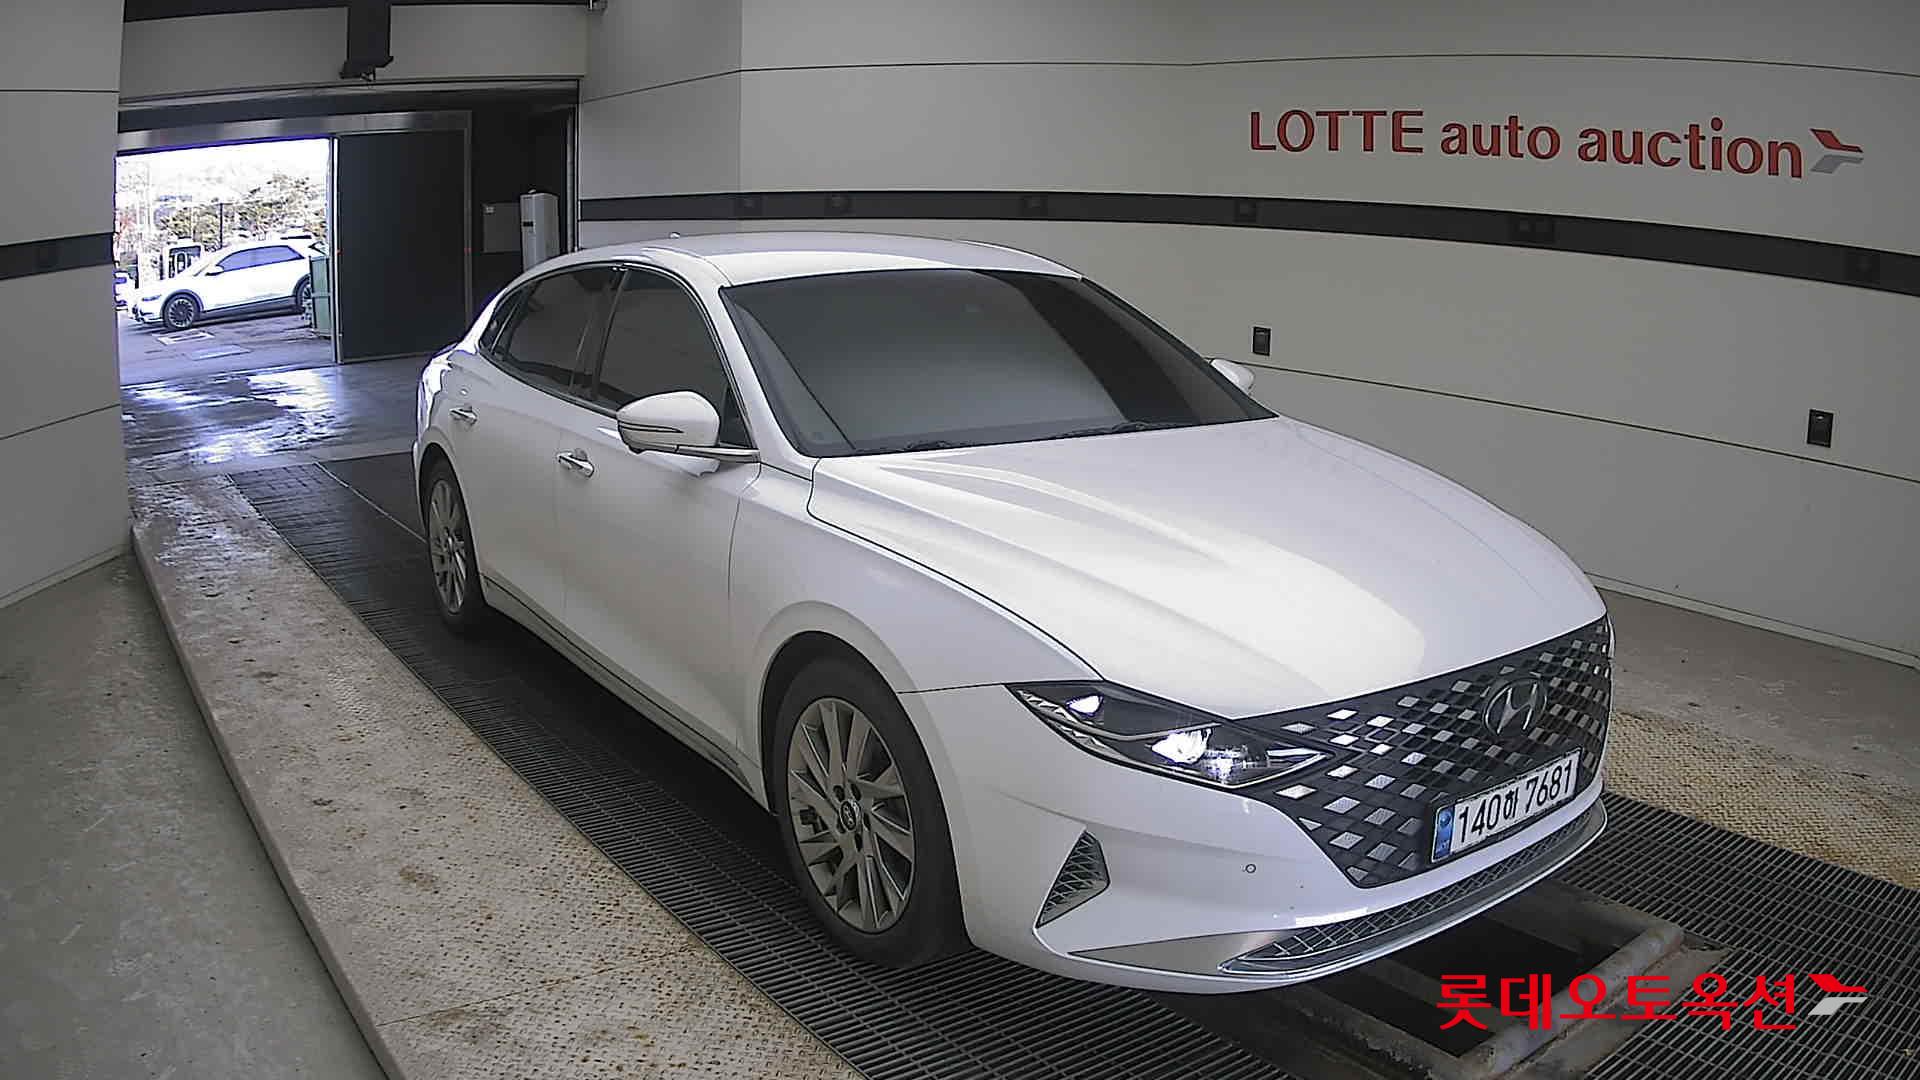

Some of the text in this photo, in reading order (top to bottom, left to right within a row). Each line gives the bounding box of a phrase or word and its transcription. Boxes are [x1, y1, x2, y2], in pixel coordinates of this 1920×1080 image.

[1250, 110, 1803, 179] LOTTE auto auction
[1525, 759, 1573, 814] 7681
